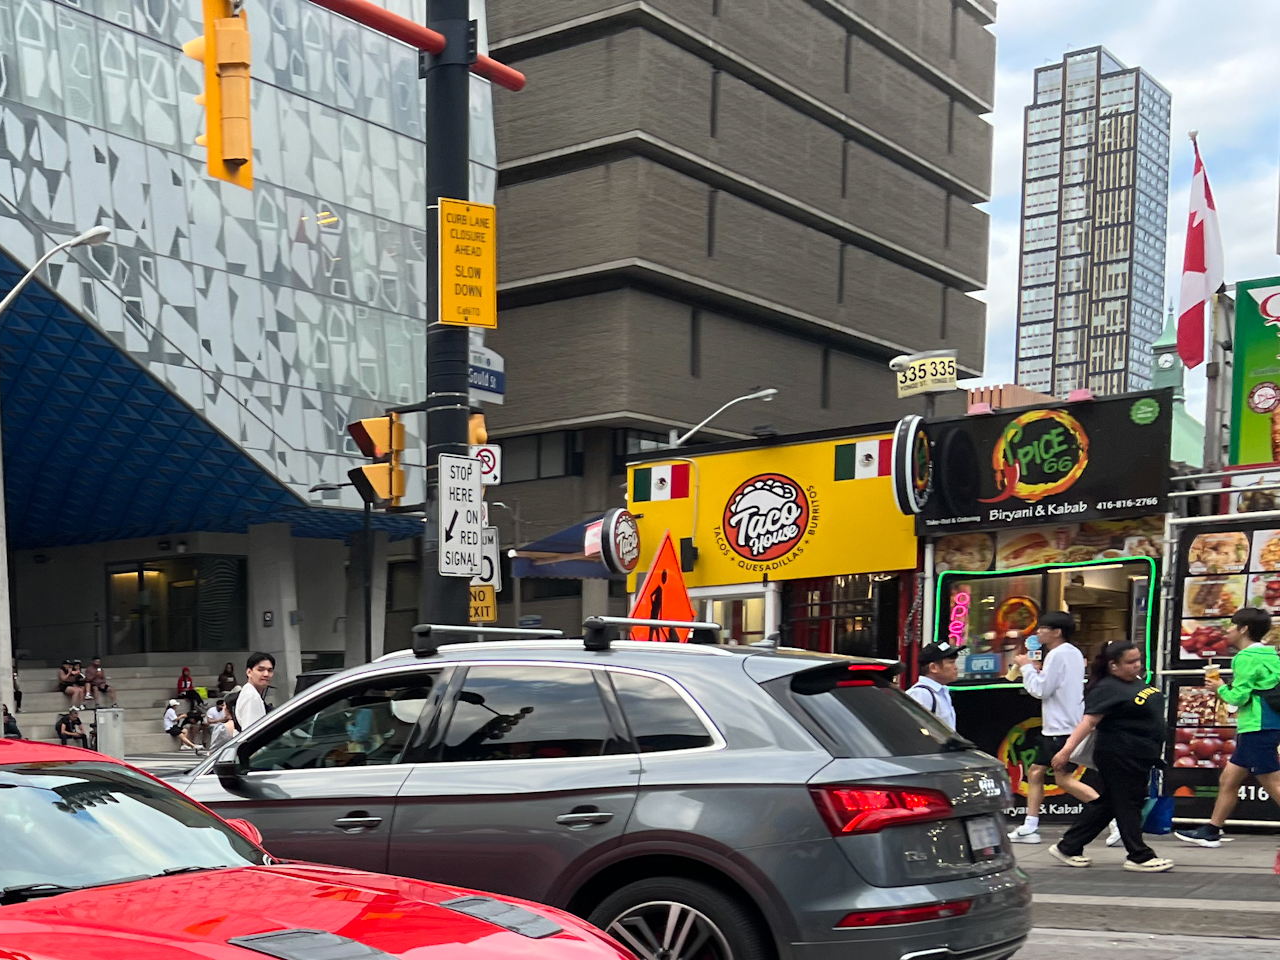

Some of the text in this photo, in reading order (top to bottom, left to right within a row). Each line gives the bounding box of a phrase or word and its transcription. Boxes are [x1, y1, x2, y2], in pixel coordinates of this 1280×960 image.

[446, 212, 490, 229] CURB LANE
[450, 228, 486, 243] CLOSURE
[455, 244, 482, 257] AHEAD
[455, 265, 482, 279] SLOW
[455, 283, 482, 297] DOWN
[900, 360, 955, 384] 335 335
[489, 375, 497, 389] St
[1043, 456, 1073, 473] 66
[450, 465, 473, 481] STOP
[449, 486, 474, 503] HERE
[989, 502, 1088, 522] Biryani & Kabab
[1096, 497, 1158, 511] 416-816-2766
[466, 510, 479, 525] ON
[729, 500, 802, 546] Taco
[713, 485, 820, 572] TACOS QUESADILLAS BURRITOS
[460, 530, 479, 546] RED
[748, 524, 799, 556] House
[445, 551, 478, 567] SIGNAL
[470, 590, 486, 602] NO
